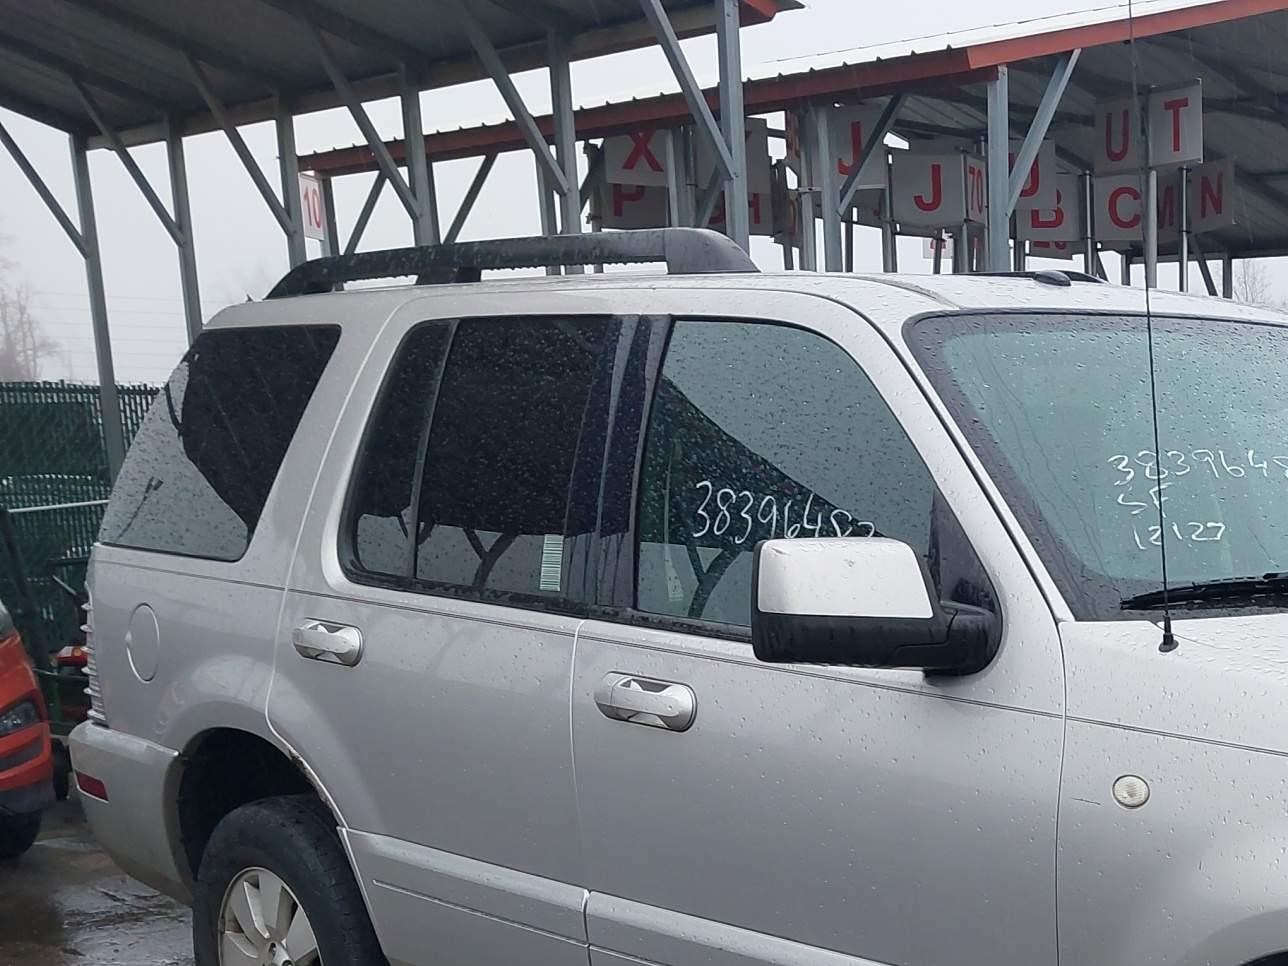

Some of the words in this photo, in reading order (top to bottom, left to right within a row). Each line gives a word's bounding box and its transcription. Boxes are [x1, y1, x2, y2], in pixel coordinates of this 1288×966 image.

[1106, 109, 1129, 161] U
[1164, 97, 1189, 152] T
[303, 187, 321, 229] 10
[913, 164, 942, 211] J
[1108, 186, 1141, 229] C
[1201, 172, 1223, 218] N
